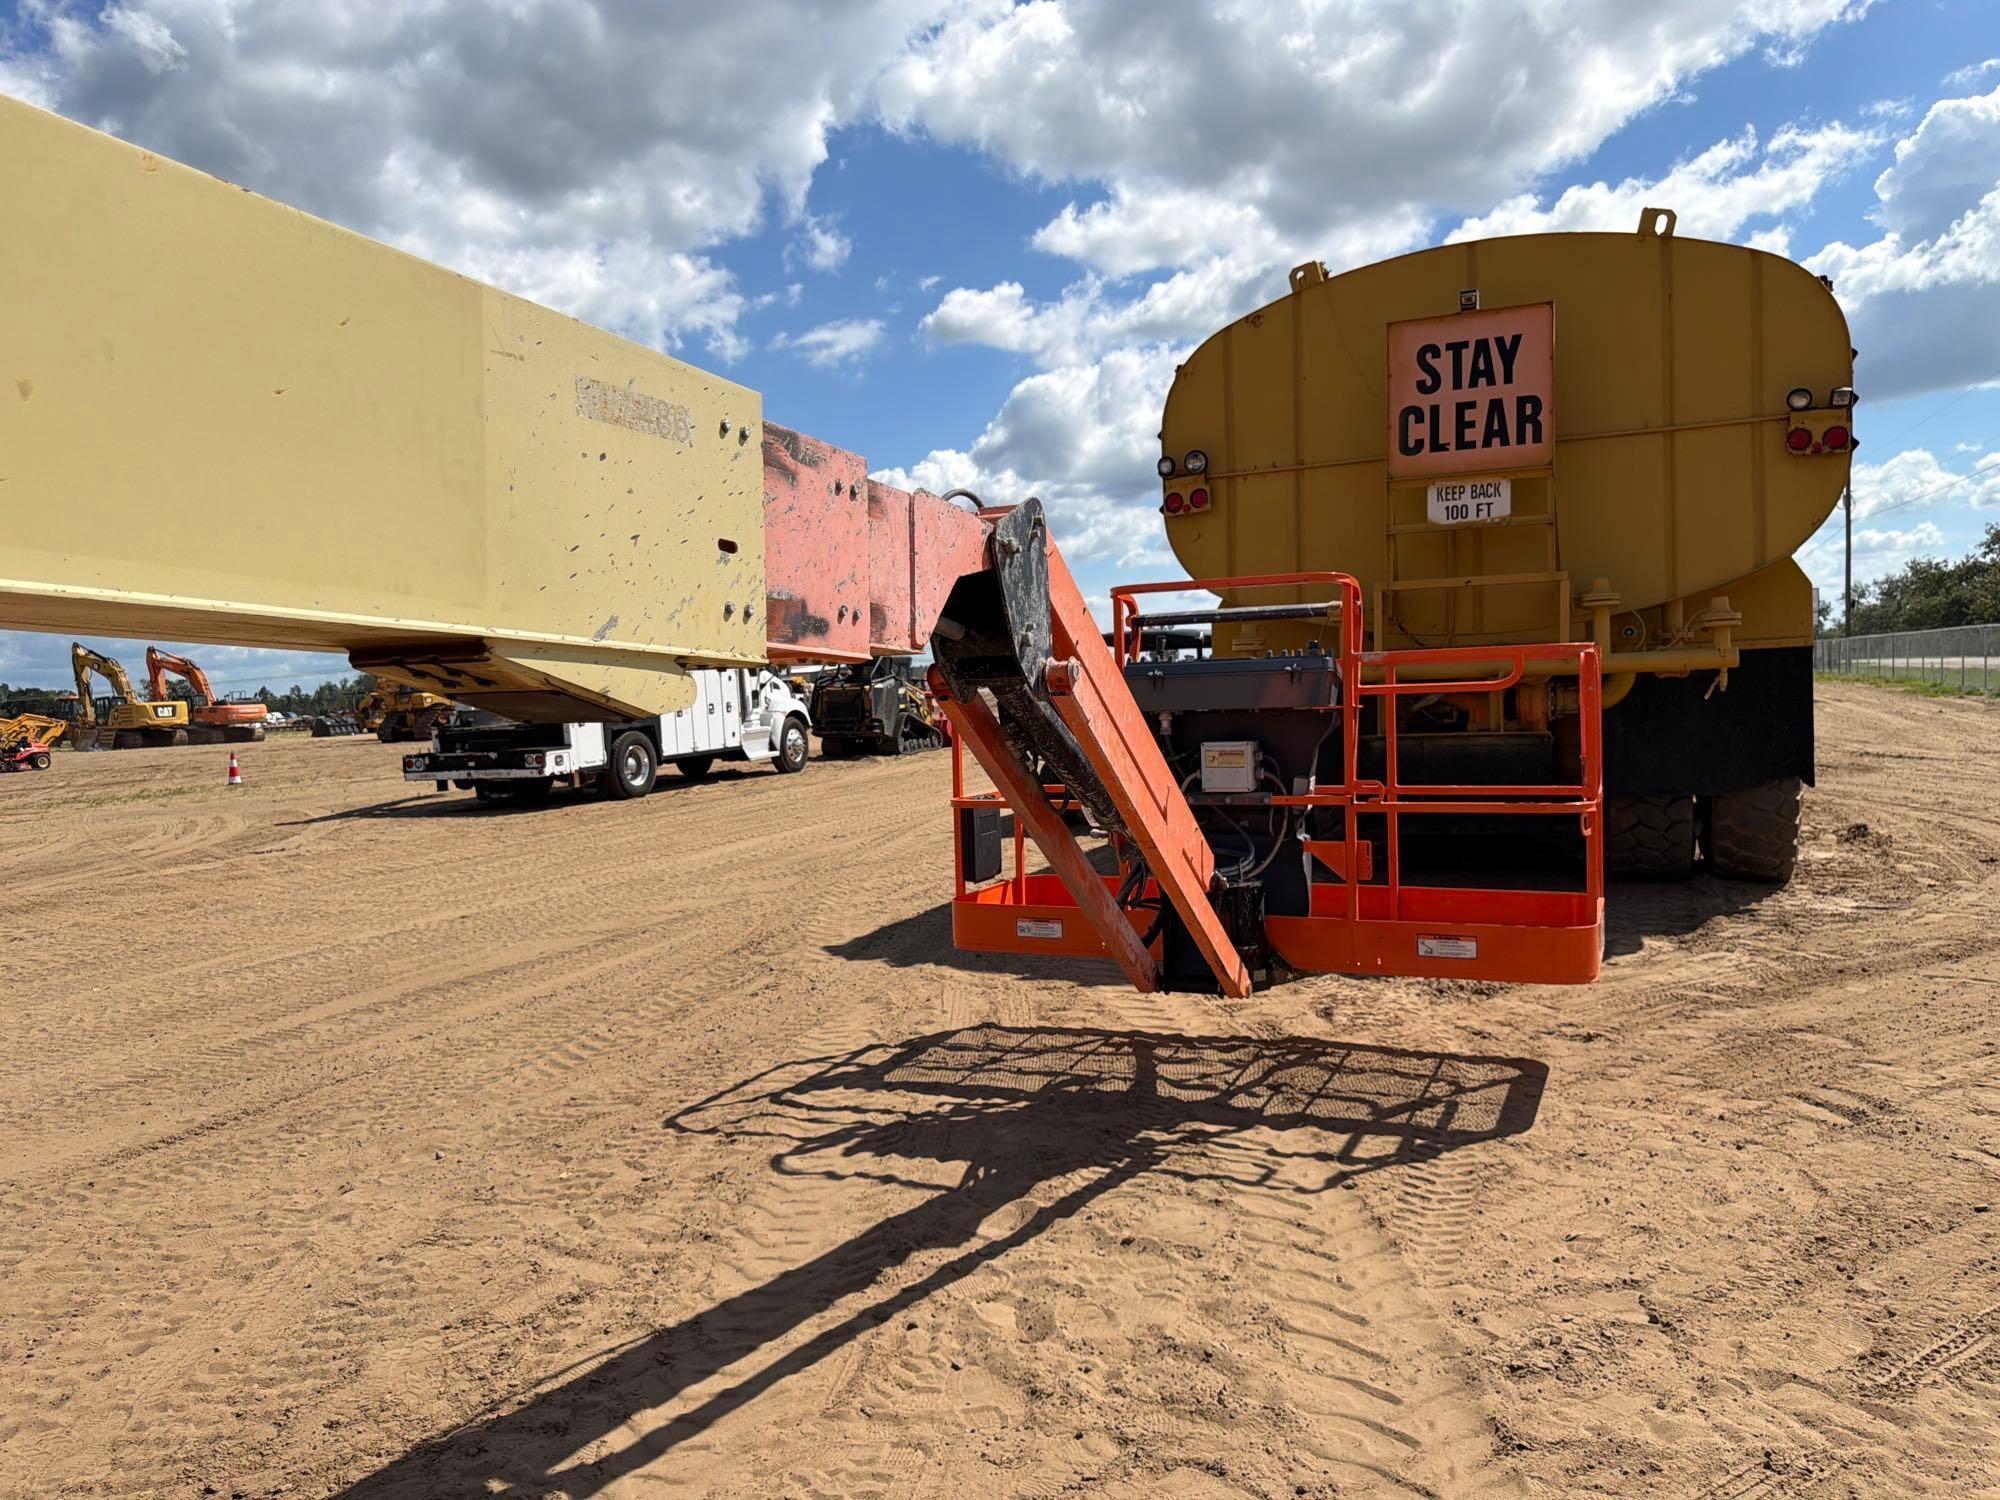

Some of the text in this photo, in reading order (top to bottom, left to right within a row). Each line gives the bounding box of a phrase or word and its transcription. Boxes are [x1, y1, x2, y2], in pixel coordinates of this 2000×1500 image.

[1416, 334, 1523, 395] STAY
[1399, 395, 1543, 456] CLEAR
[1436, 482, 1502, 502] KEEP BACK
[1444, 502, 1494, 520] 100 FT
[157, 706, 173, 717] CAT
